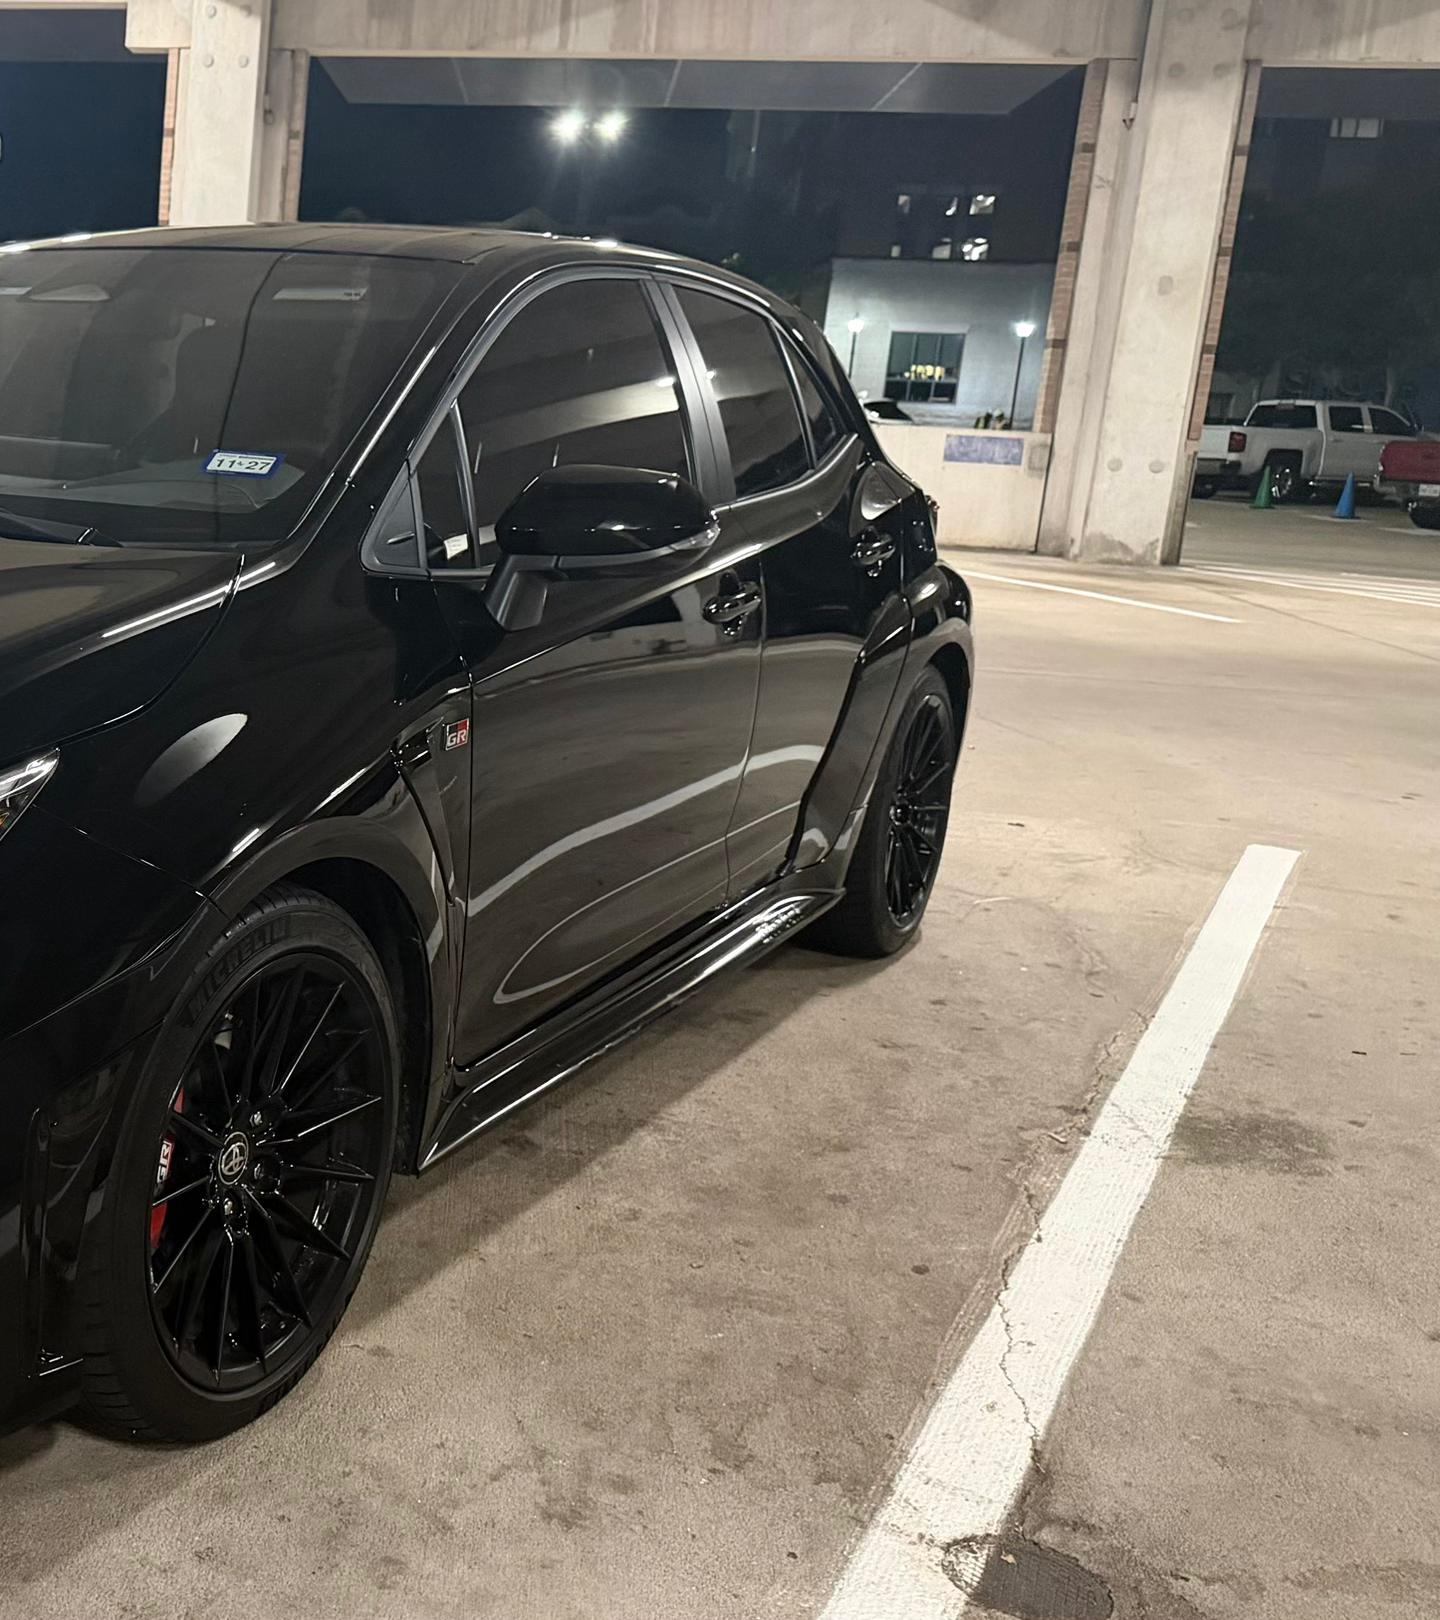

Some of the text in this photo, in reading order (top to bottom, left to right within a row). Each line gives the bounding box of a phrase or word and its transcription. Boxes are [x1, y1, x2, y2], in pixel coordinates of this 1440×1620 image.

[216, 458, 271, 470] 11 27
[447, 730, 467, 747] GR
